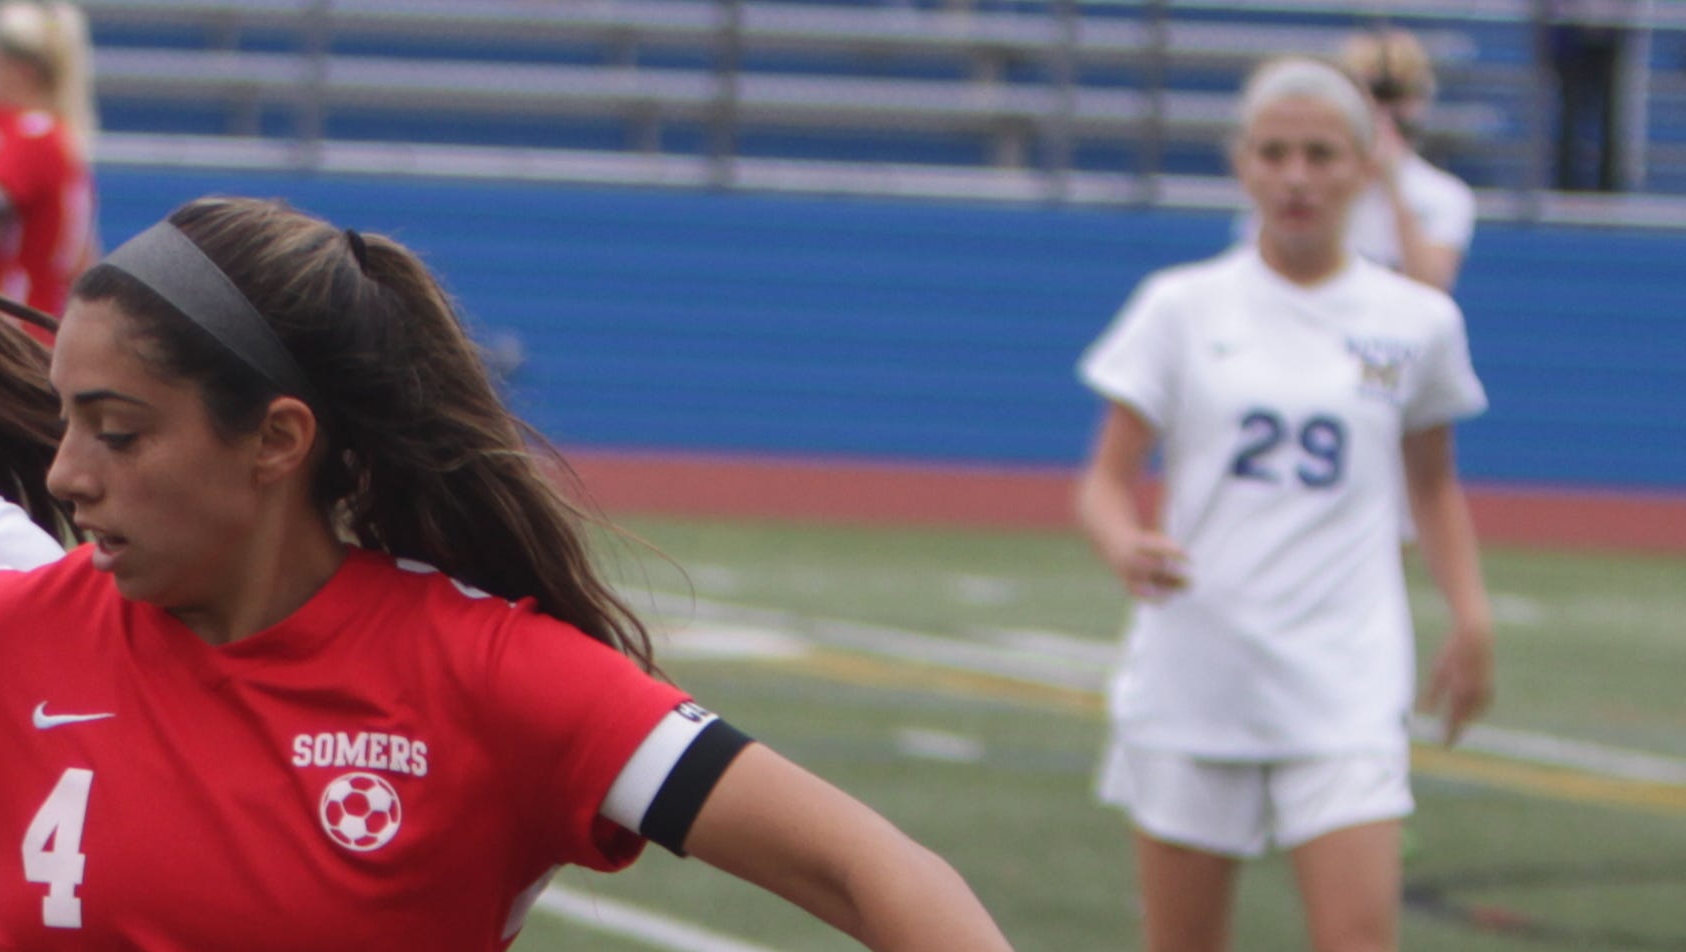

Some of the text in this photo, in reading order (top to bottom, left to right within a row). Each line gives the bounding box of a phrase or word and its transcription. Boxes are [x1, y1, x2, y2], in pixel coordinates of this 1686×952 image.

[1230, 406, 1348, 489] 29
[292, 731, 428, 777] SOMERS
[22, 767, 94, 928] 4
